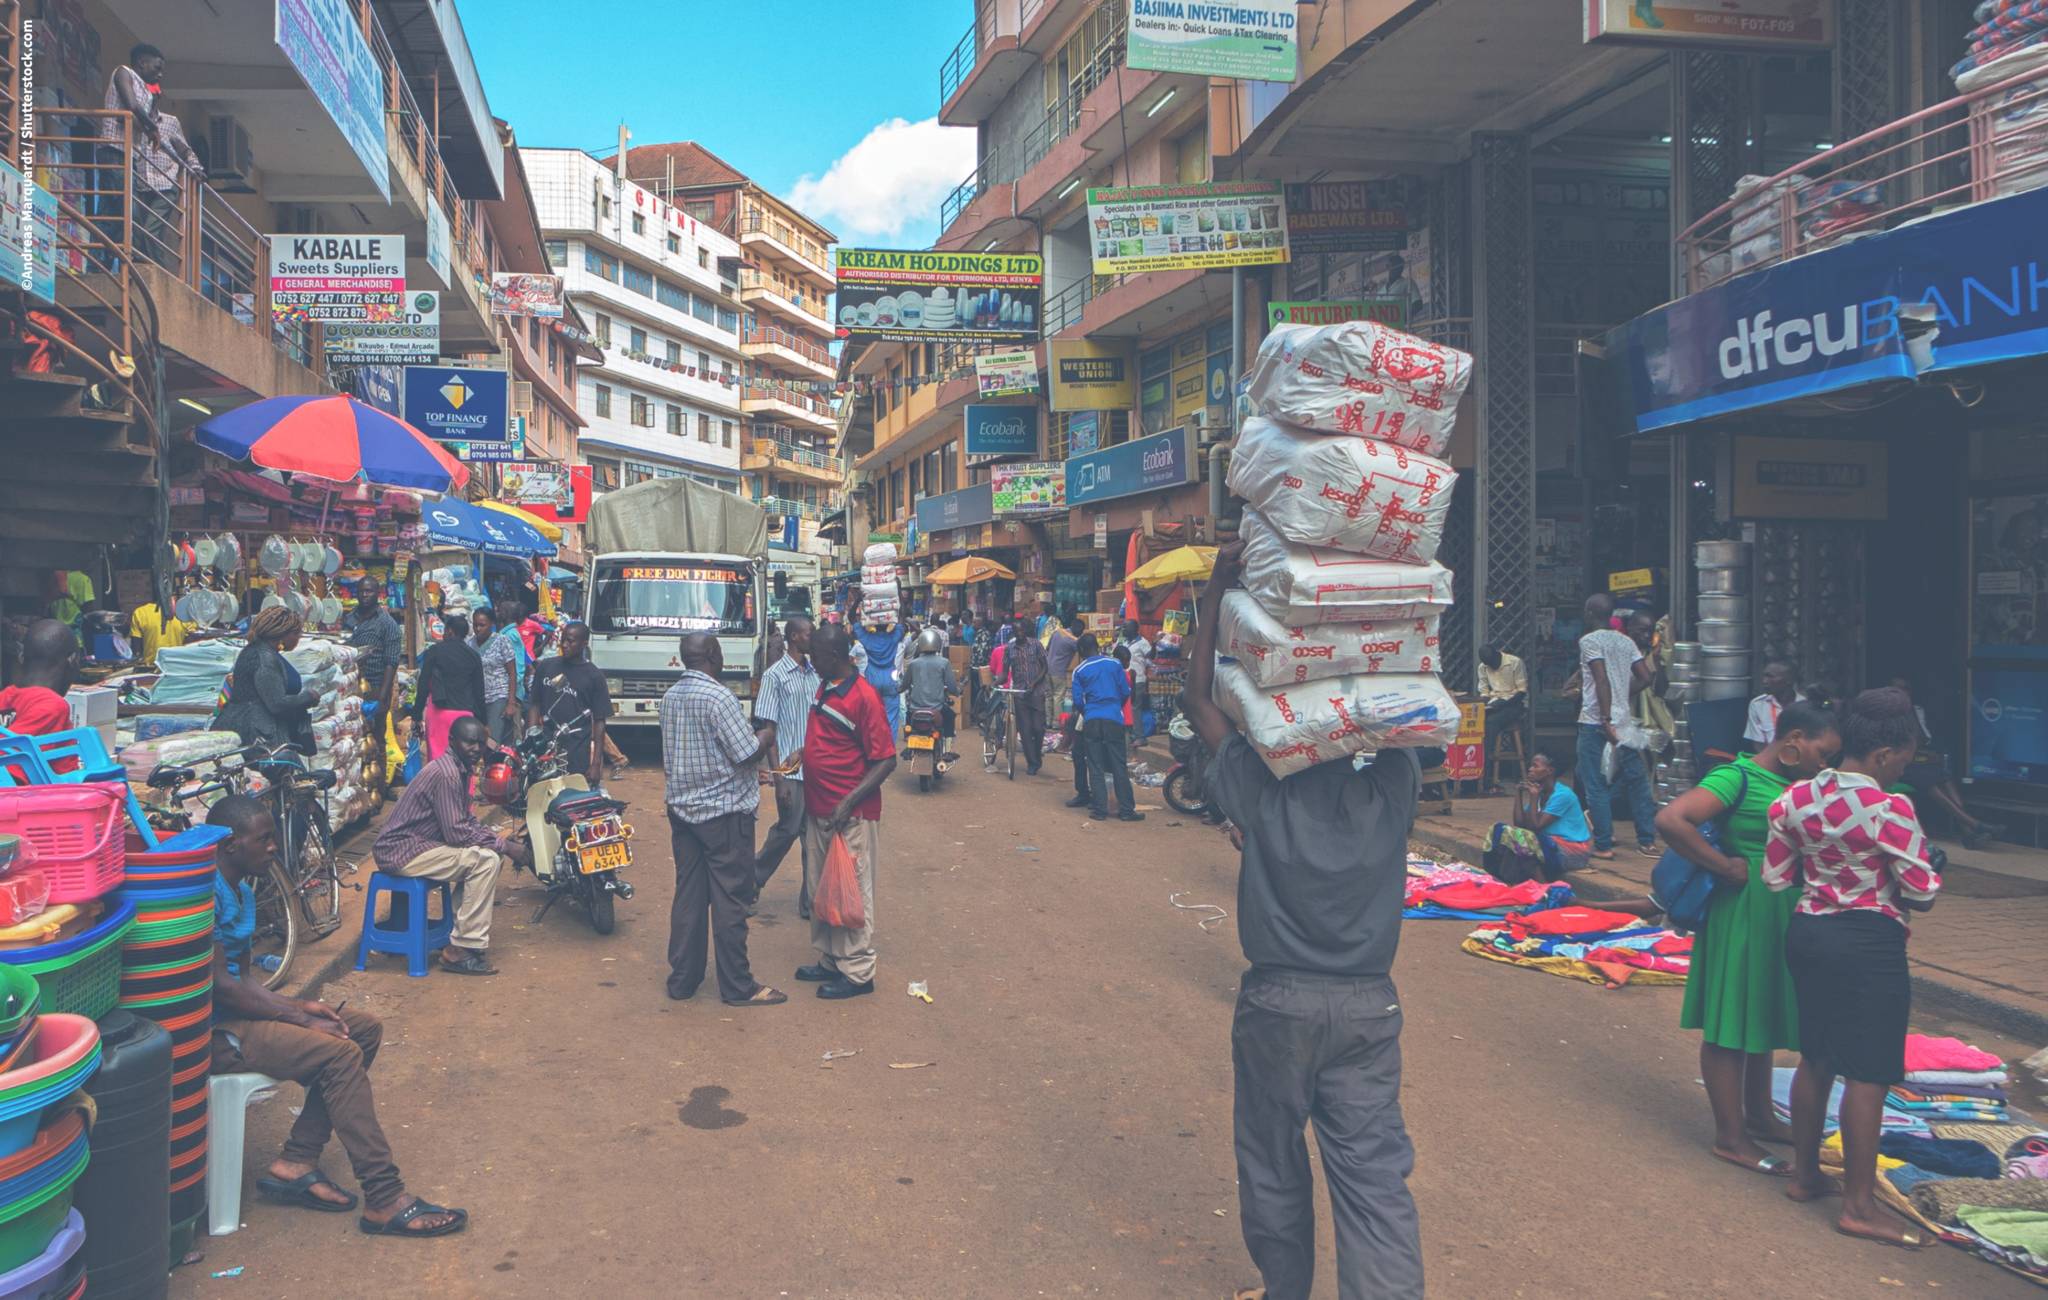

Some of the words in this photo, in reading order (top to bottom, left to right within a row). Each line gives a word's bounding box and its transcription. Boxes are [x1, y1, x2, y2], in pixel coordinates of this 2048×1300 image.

[1134, 0, 1185, 19] BASIIMA
[1188, 4, 1268, 26] INVESTMENTS
[1272, 12, 1295, 29] LTD
[1135, 18, 1165, 31] Dealers
[1183, 23, 1206, 34] Quick
[1208, 26, 1232, 36] Loans
[1255, 30, 1288, 43] Clearing
[1311, 184, 1366, 210] NISSEI
[635, 189, 697, 236] GIANT
[1289, 212, 1365, 228] RADEWAYS
[293, 238, 382, 260] KABALE
[278, 262, 330, 274] Sweets
[334, 262, 399, 277] Suppliers
[840, 251, 905, 269] KREAM
[910, 254, 1002, 273] HOLDINGS
[1006, 258, 1039, 273] LTD
[845, 270, 889, 279] AUTHORISED
[890, 272, 935, 281] DISTRIBUTOR
[285, 280, 325, 289] GENERAL
[276, 294, 298, 303] 0752
[299, 294, 316, 303] 627
[318, 294, 334, 303] 447
[341, 294, 363, 303] 0772
[364, 294, 381, 303] 627
[383, 294, 398, 303] 447
[309, 308, 330, 318] 0752
[332, 308, 349, 318] 872
[350, 308, 367, 318] 879
[1718, 303, 1859, 380] dfcu
[1063, 362, 1112, 371] WESTERN
[1079, 370, 1112, 378] UNION
[425, 412, 445, 422] TOP
[446, 413, 488, 424] FINANCE
[979, 421, 1026, 436] Ecobank
[1143, 448, 1173, 471] Ecobank
[1097, 464, 1111, 483] ATM
[596, 844, 620, 857] UED
[594, 855, 622, 869] 634Y
